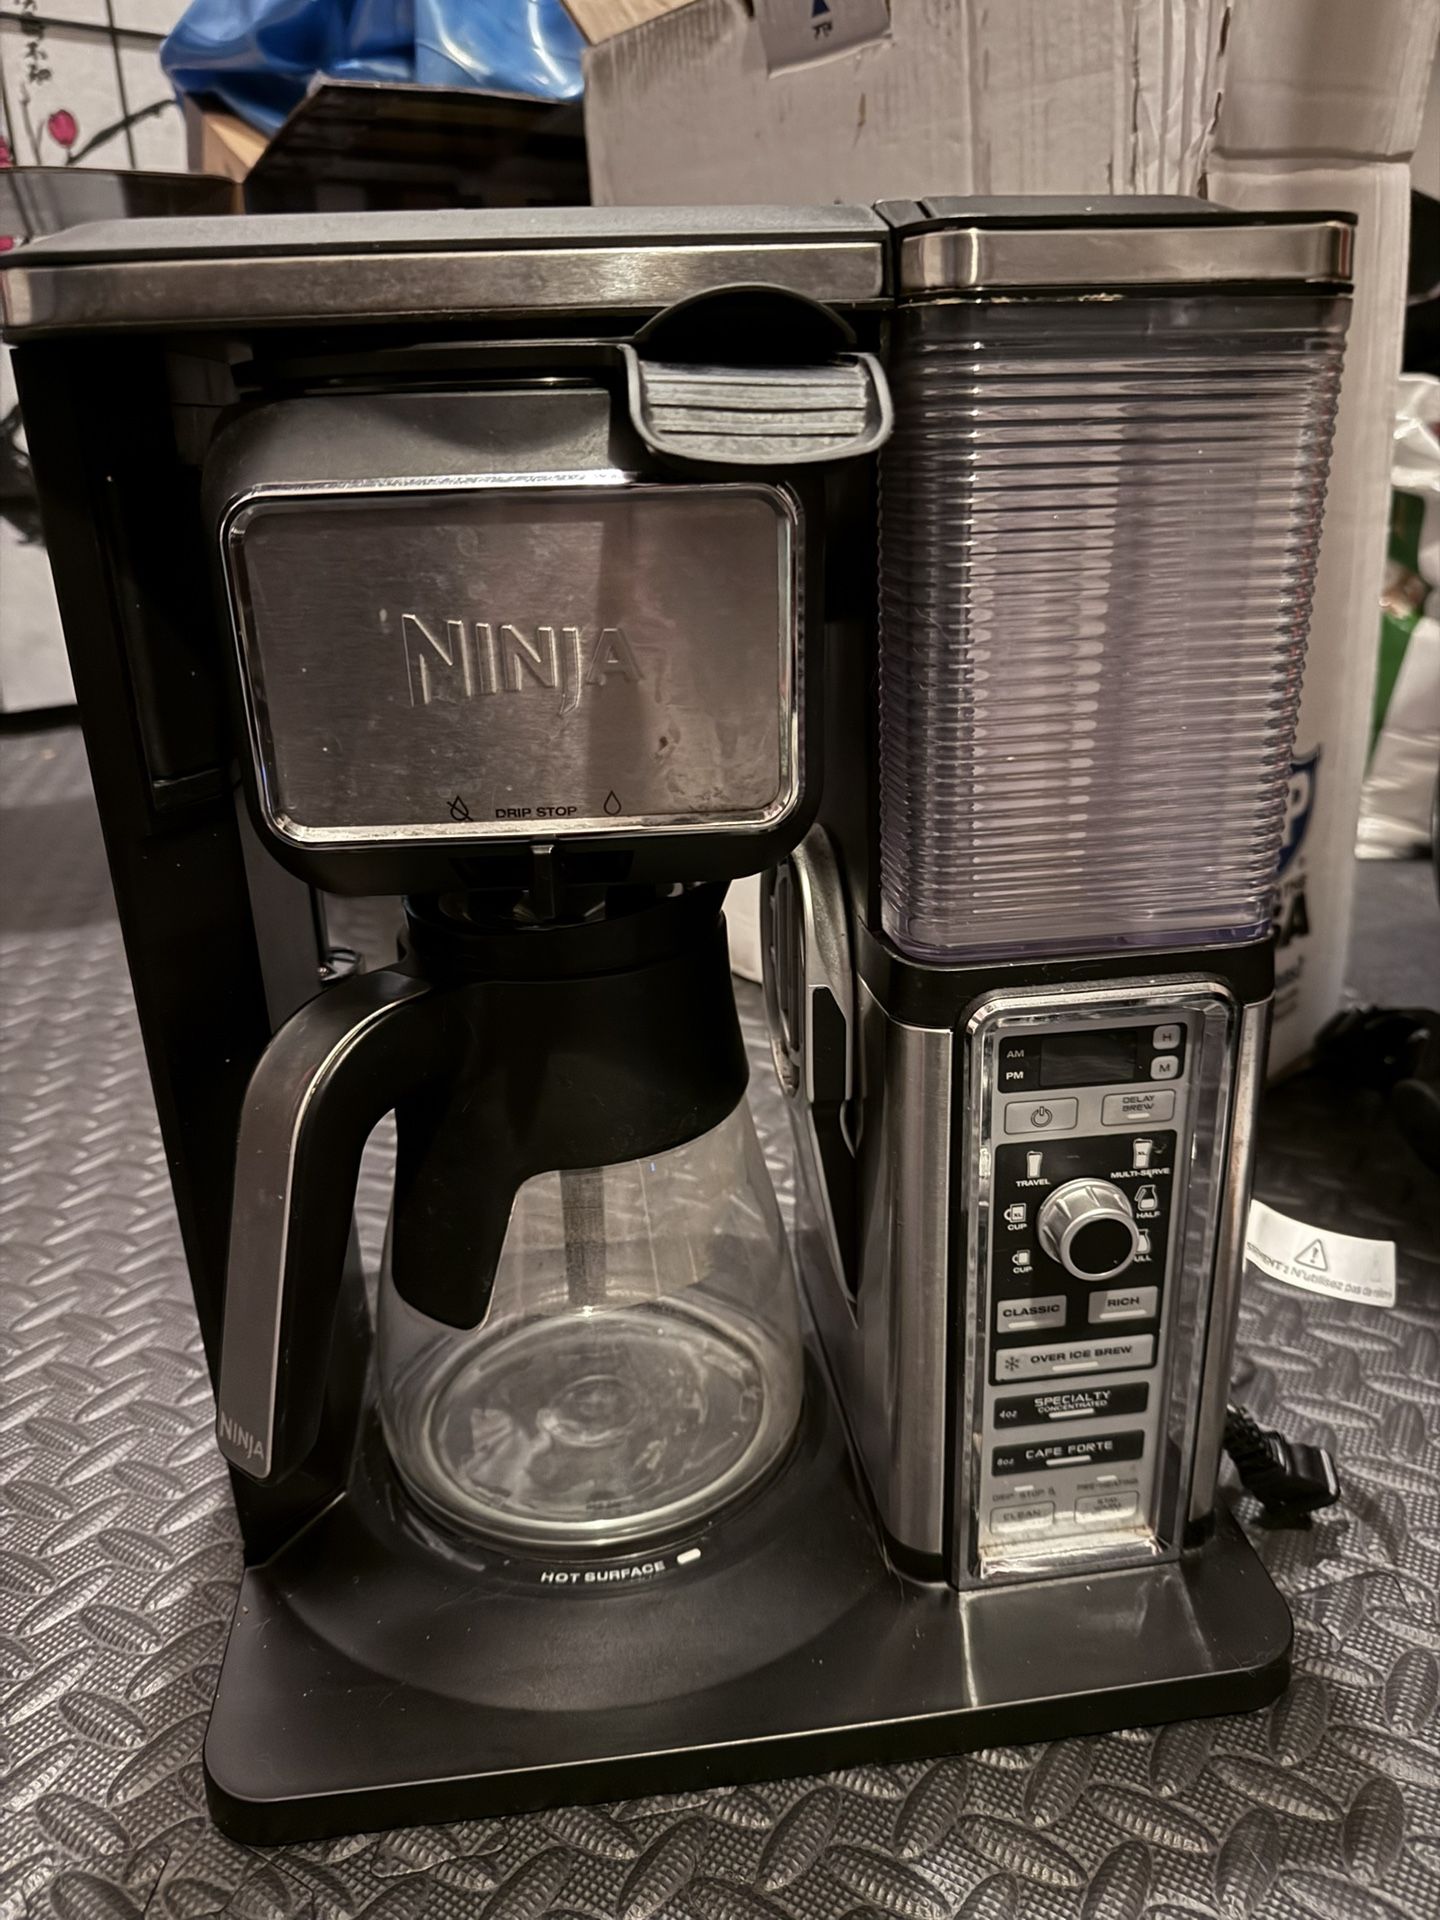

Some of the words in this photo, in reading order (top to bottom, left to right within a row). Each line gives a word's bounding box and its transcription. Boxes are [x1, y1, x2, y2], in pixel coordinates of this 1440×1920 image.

[402, 613, 645, 719] NINJA
[495, 807, 532, 819] DRIP
[536, 806, 577, 818] STOP
[1162, 1032, 1172, 1042] H
[1007, 1050, 1025, 1059] AM
[1159, 1062, 1171, 1073] M
[1006, 1071, 1024, 1081] PM
[1122, 1094, 1155, 1105] DELAY
[1122, 1103, 1155, 1113] BREW
[1110, 1167, 1170, 1179] MULTI-SERVE
[1016, 1178, 1051, 1188] TRAVEL
[1136, 1210, 1160, 1219] HALF
[1007, 1223, 1028, 1231] CUP
[1132, 1254, 1152, 1263] ULL
[1012, 1265, 1033, 1274] CUP
[1107, 1297, 1140, 1307] RICH
[1003, 1304, 1060, 1317] CLASSIC
[1030, 1352, 1066, 1364] OVER
[1069, 1349, 1090, 1359] ICE
[1094, 1345, 1133, 1356] BREW
[1034, 1390, 1111, 1408] SPECIALTY
[1037, 1400, 1108, 1414] CONCENTRATED
[220, 1410, 265, 1460] NINJA
[1025, 1446, 1062, 1460] CAFE
[1067, 1440, 1113, 1454] FORTE
[540, 1571, 581, 1584] HOT
[584, 1561, 665, 1582] SURFACE
